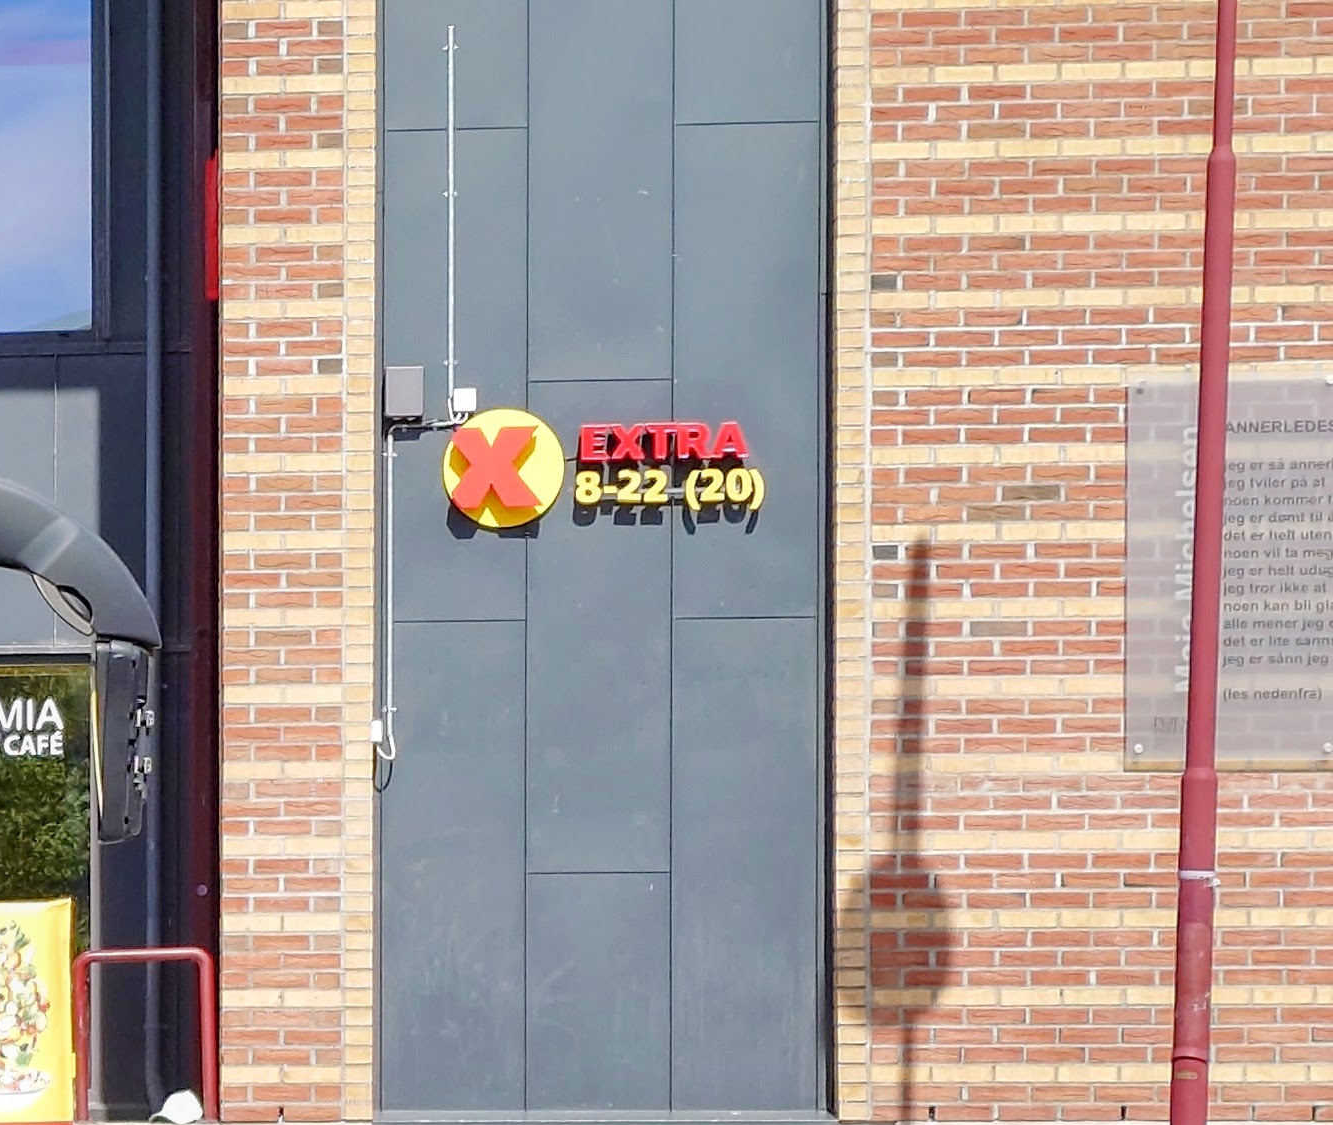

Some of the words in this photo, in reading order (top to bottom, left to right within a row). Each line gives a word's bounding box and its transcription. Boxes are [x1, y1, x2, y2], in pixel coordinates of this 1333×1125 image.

[579, 421, 750, 463] EXTRA
[1227, 461, 1245, 473] eg
[1250, 461, 1263, 470] er
[1268, 458, 1284, 470] så
[575, 468, 668, 504] 8-22
[685, 467, 765, 513] (20)
[1227, 479, 1245, 491] eg
[1250, 477, 1286, 488] tviler
[1291, 475, 1307, 490] på
[1224, 496, 1259, 506] noen
[1264, 494, 1323, 505] kommer
[1224, 512, 1245, 526] jeg
[1250, 514, 1263, 523] er
[1310, 512, 1323, 522] til
[1224, 530, 1245, 541] det
[1250, 532, 1264, 541] er
[1269, 530, 1295, 541] helt
[1301, 530, 1332, 541] uten
[1224, 549, 1259, 559] noen
[1264, 547, 1280, 559] vil
[1285, 548, 1298, 559] ta
[1223, 565, 1245, 580] jeg
[1249, 566, 1263, 576] er
[1268, 565, 1294, 576] helt
[1223, 583, 1245, 597] jeg
[1249, 583, 1276, 594] tror
[1280, 582, 1309, 594] ikke
[1313, 582, 1327, 594] at
[1223, 602, 1259, 612] noen
[1264, 600, 1290, 612] kan
[1294, 600, 1311, 611] bli
[1223, 618, 1247, 630] alle
[1253, 619, 1297, 629] mener
[1301, 618, 1324, 632] jeg
[1223, 635, 1245, 646] det
[1250, 637, 1264, 646] er
[1222, 654, 1244, 668] jeg
[1249, 655, 1264, 664] er
[1306, 653, 1329, 667] jeg
[1223, 687, 1248, 702] (les
[1253, 687, 1322, 701] nedenfra)
[3, 731, 64, 756] CAFÉ
